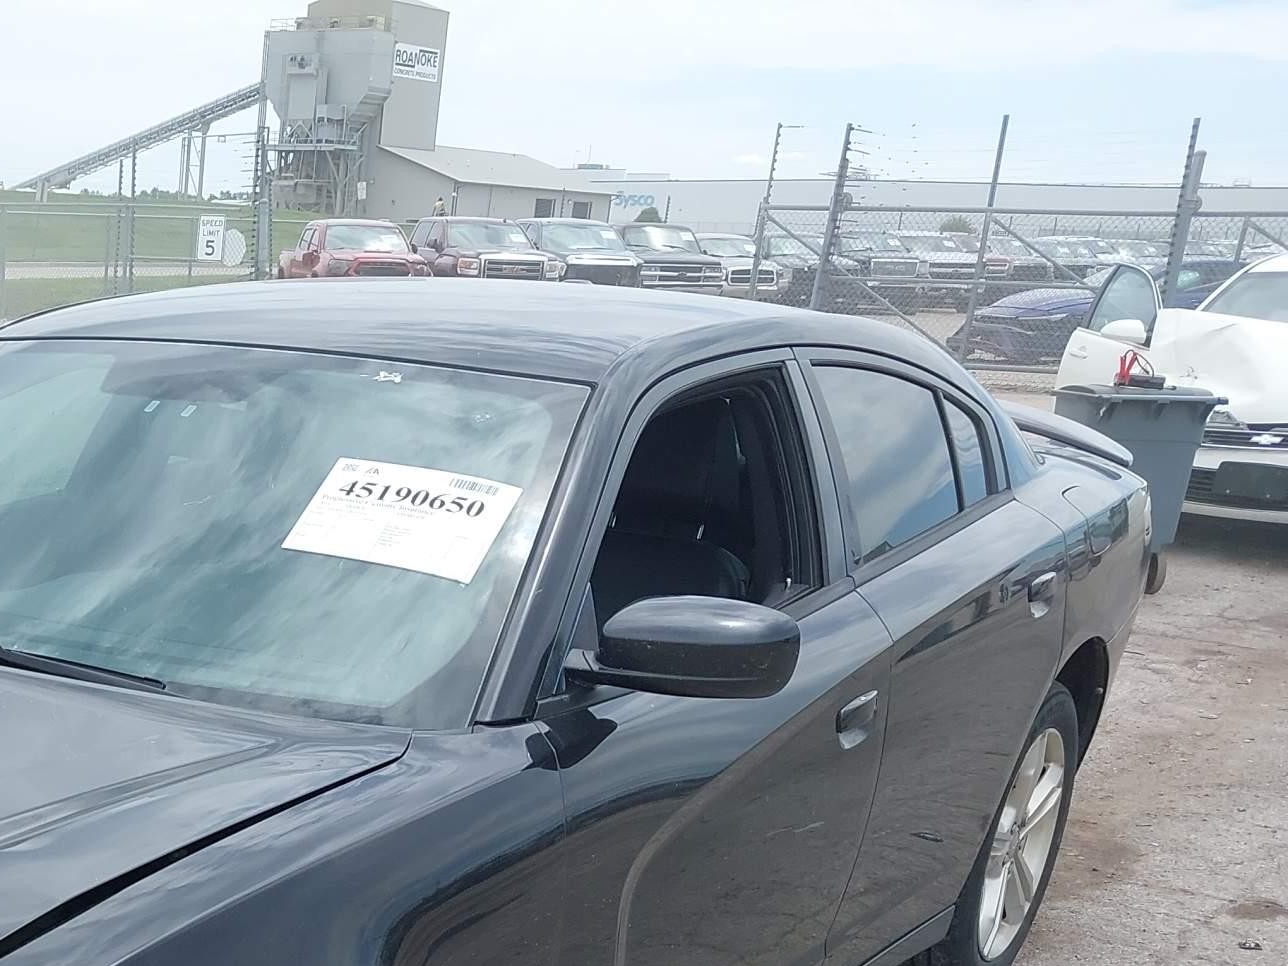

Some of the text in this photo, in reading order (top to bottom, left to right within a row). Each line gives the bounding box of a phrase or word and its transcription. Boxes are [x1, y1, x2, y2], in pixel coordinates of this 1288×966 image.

[395, 48, 439, 68] ROANOKE
[415, 71, 437, 80] PRODUCTS
[202, 219, 224, 227] SPEED
[205, 240, 215, 256] 5
[338, 480, 485, 518] 45190650
